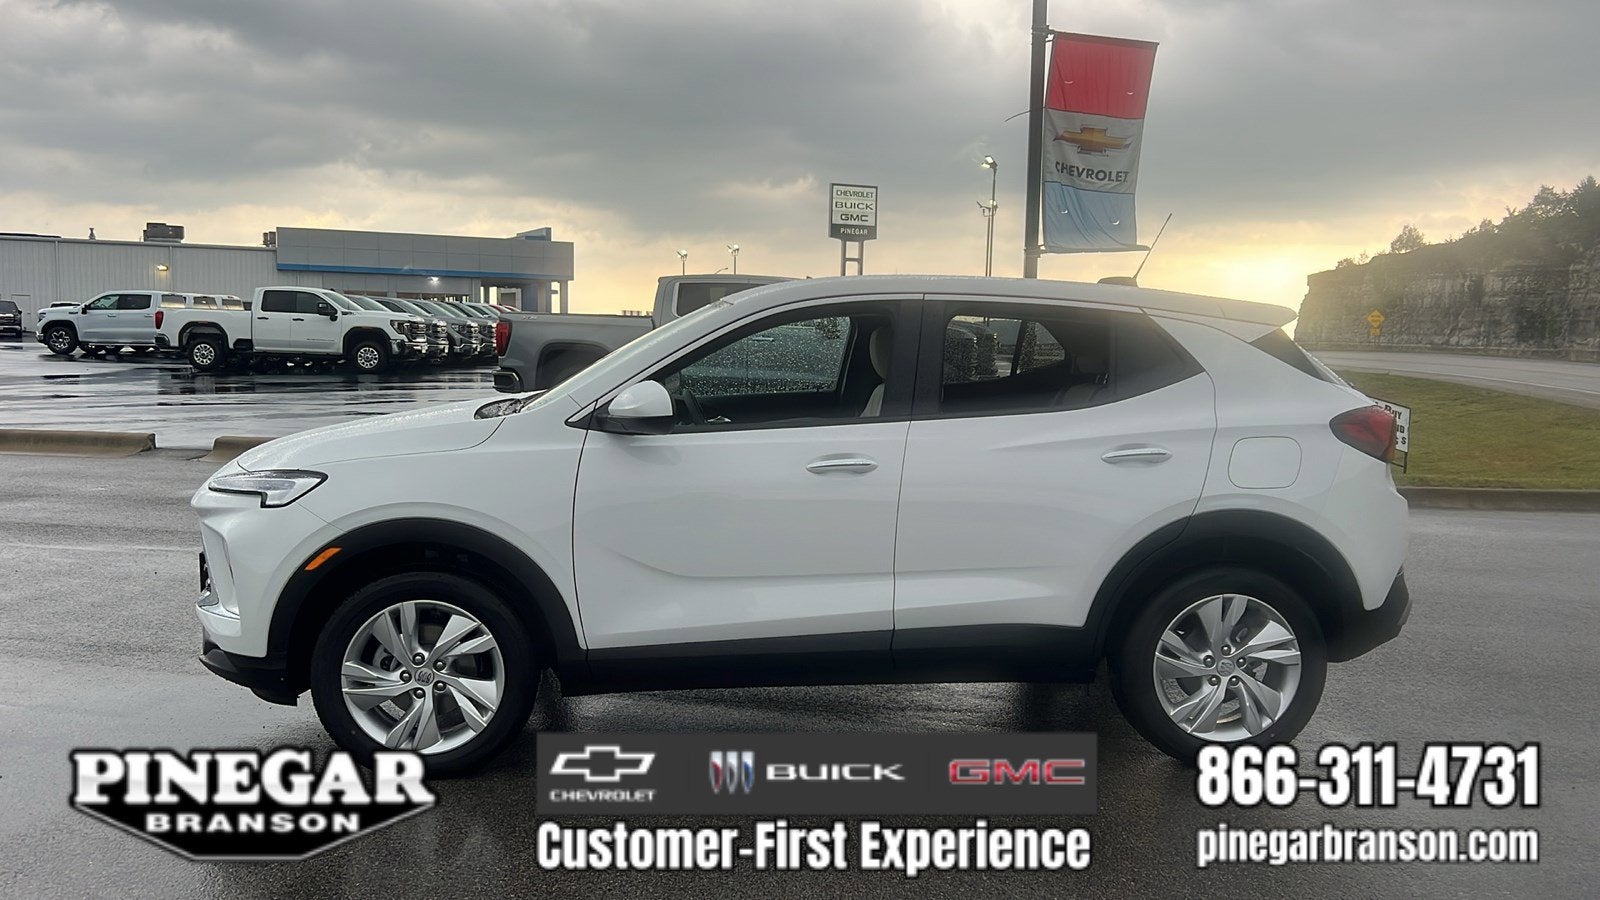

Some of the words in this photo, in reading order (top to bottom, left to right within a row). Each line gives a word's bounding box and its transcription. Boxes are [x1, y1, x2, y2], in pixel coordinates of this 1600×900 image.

[1055, 161, 1130, 183] CHEVROLET
[836, 190, 874, 198] CHEVROLET
[835, 201, 874, 210] BUICK
[840, 213, 869, 222] GMC
[840, 227, 868, 235] PINEGAR
